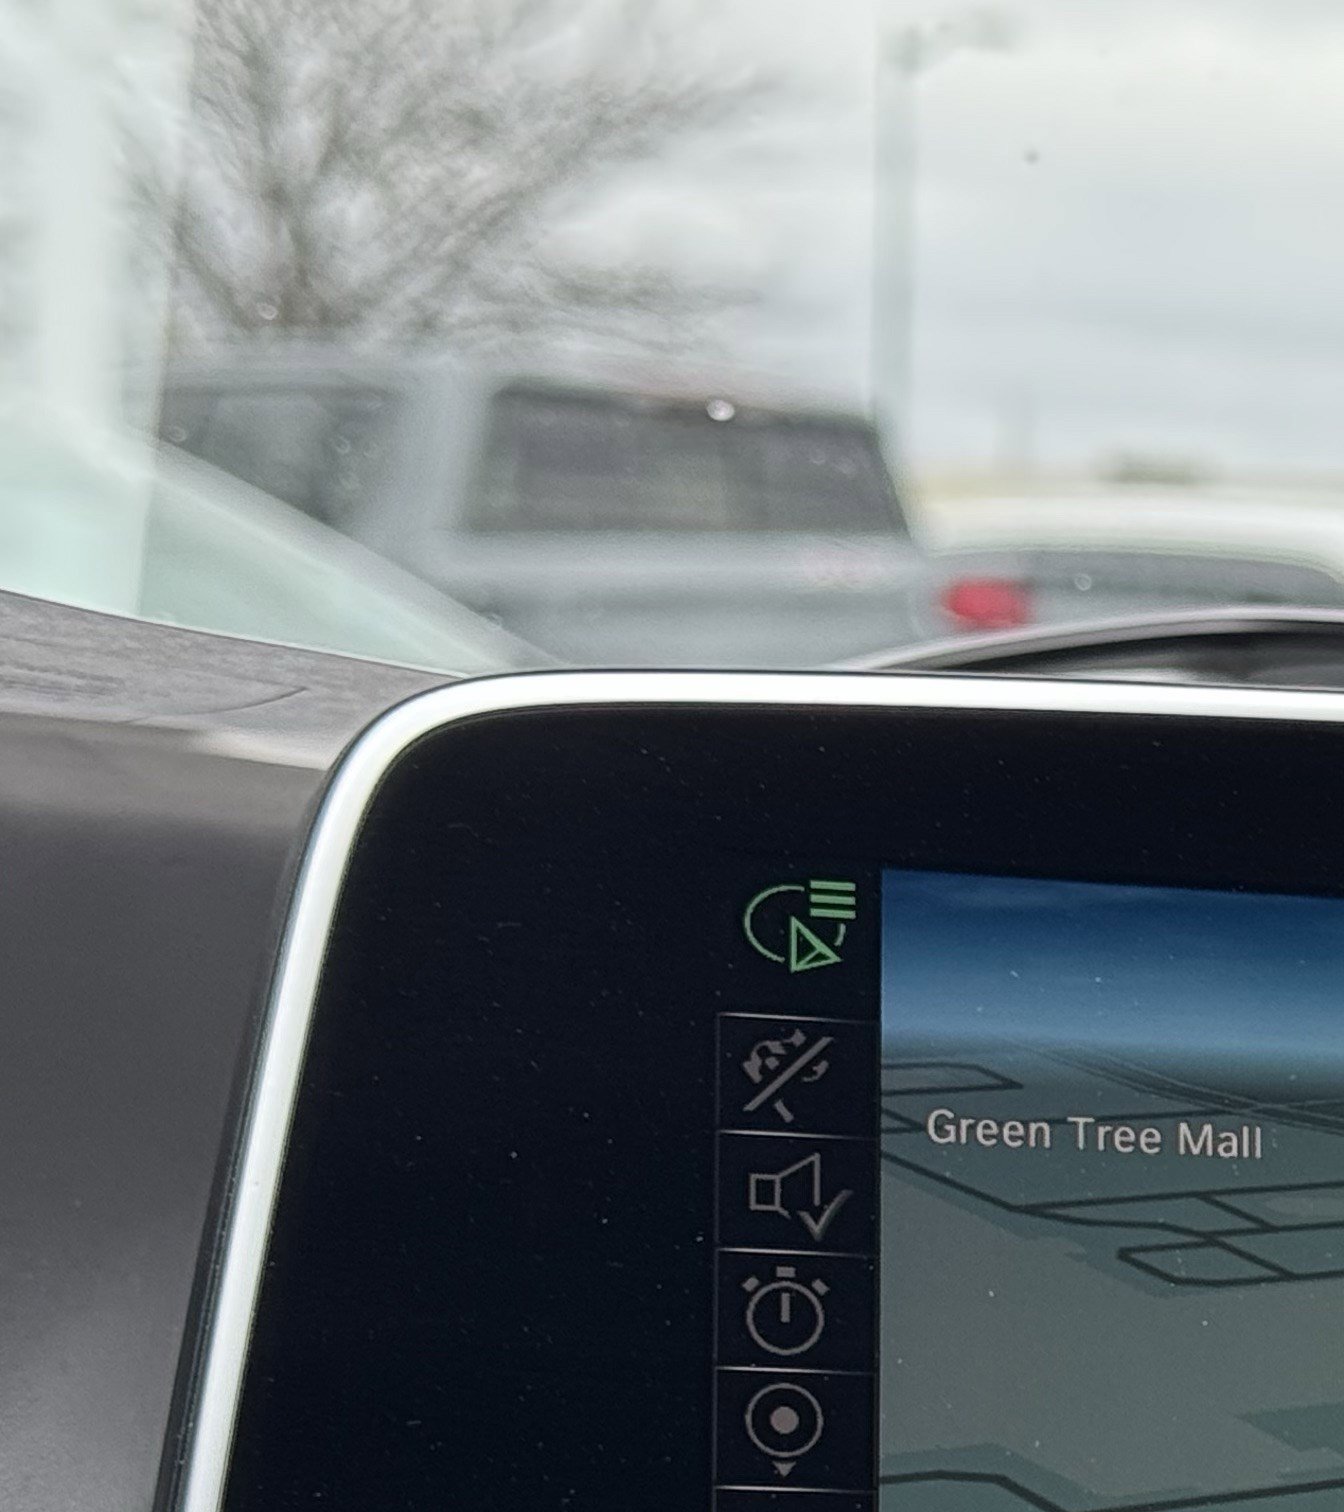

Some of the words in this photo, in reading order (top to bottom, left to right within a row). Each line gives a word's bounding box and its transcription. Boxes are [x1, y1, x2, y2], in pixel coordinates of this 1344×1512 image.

[926, 1108, 1052, 1151] Green
[1067, 1116, 1163, 1156] Tree
[1177, 1121, 1264, 1160] Mall
